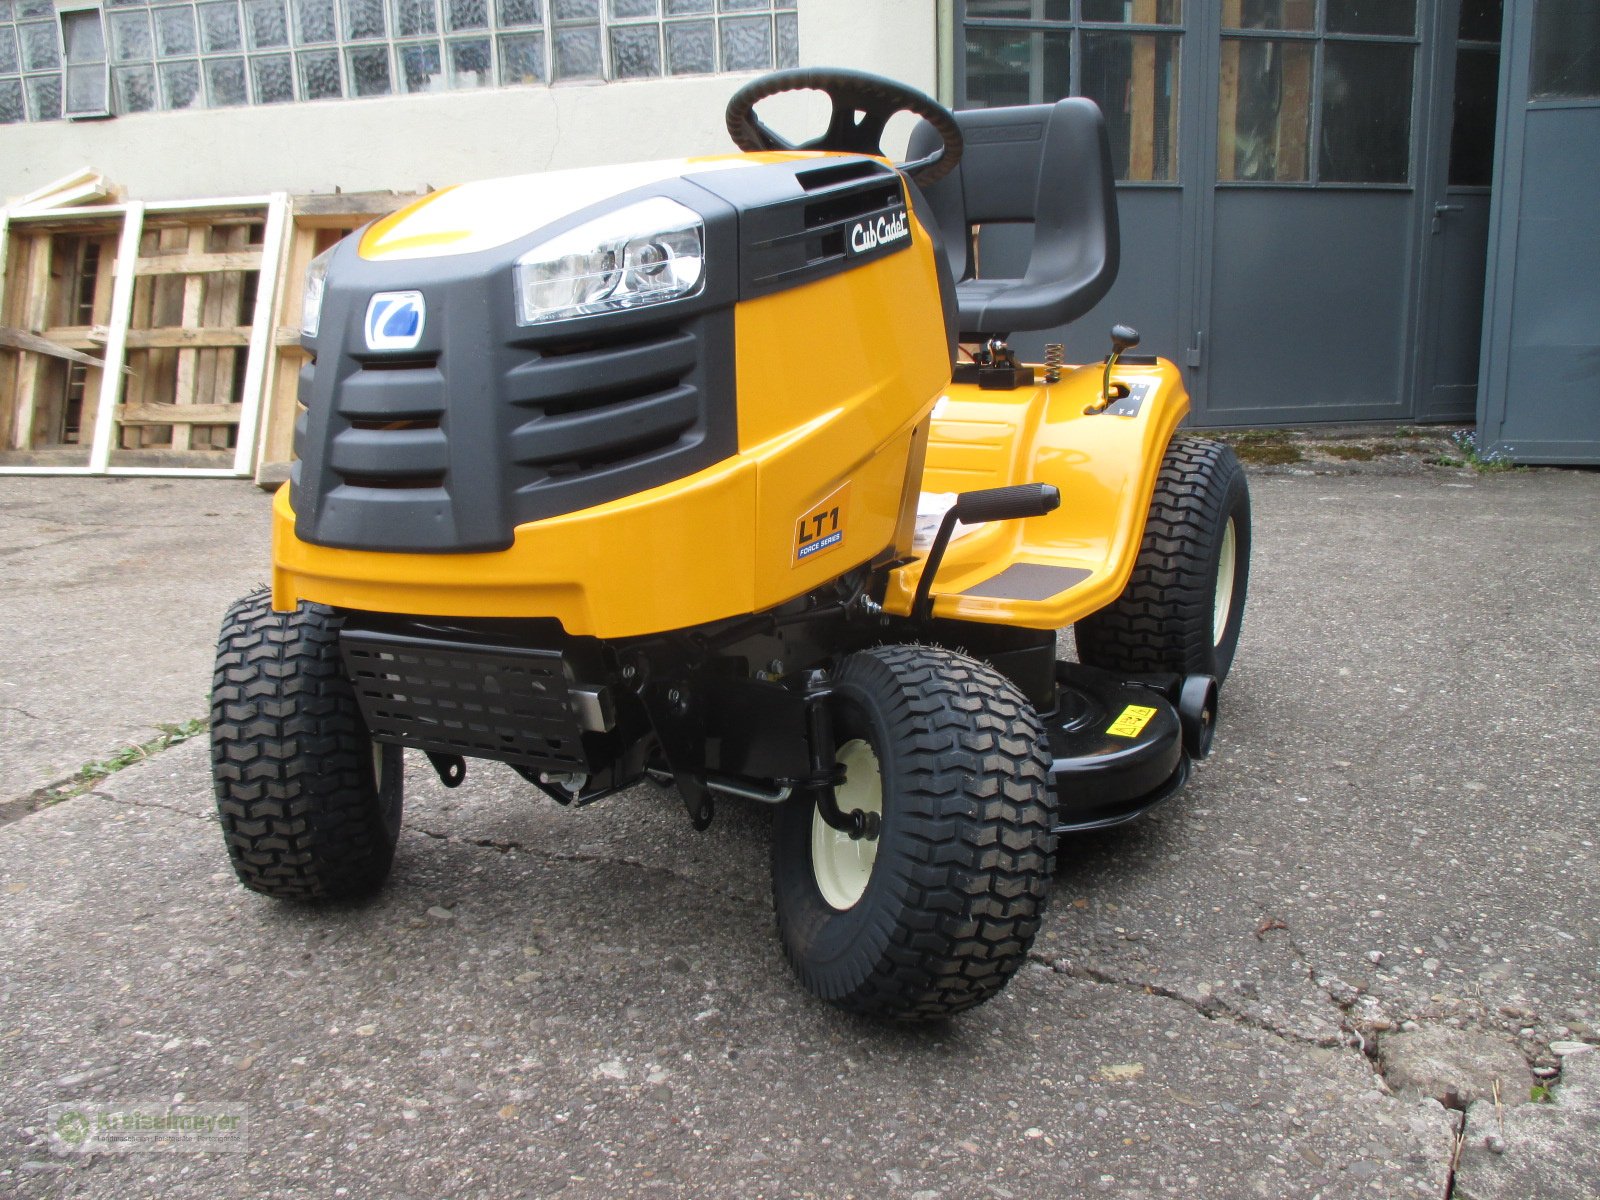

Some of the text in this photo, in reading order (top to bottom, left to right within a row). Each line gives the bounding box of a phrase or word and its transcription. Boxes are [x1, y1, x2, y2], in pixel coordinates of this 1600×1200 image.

[799, 506, 839, 544] LT1
[800, 533, 840, 557] FORCE SERIES
